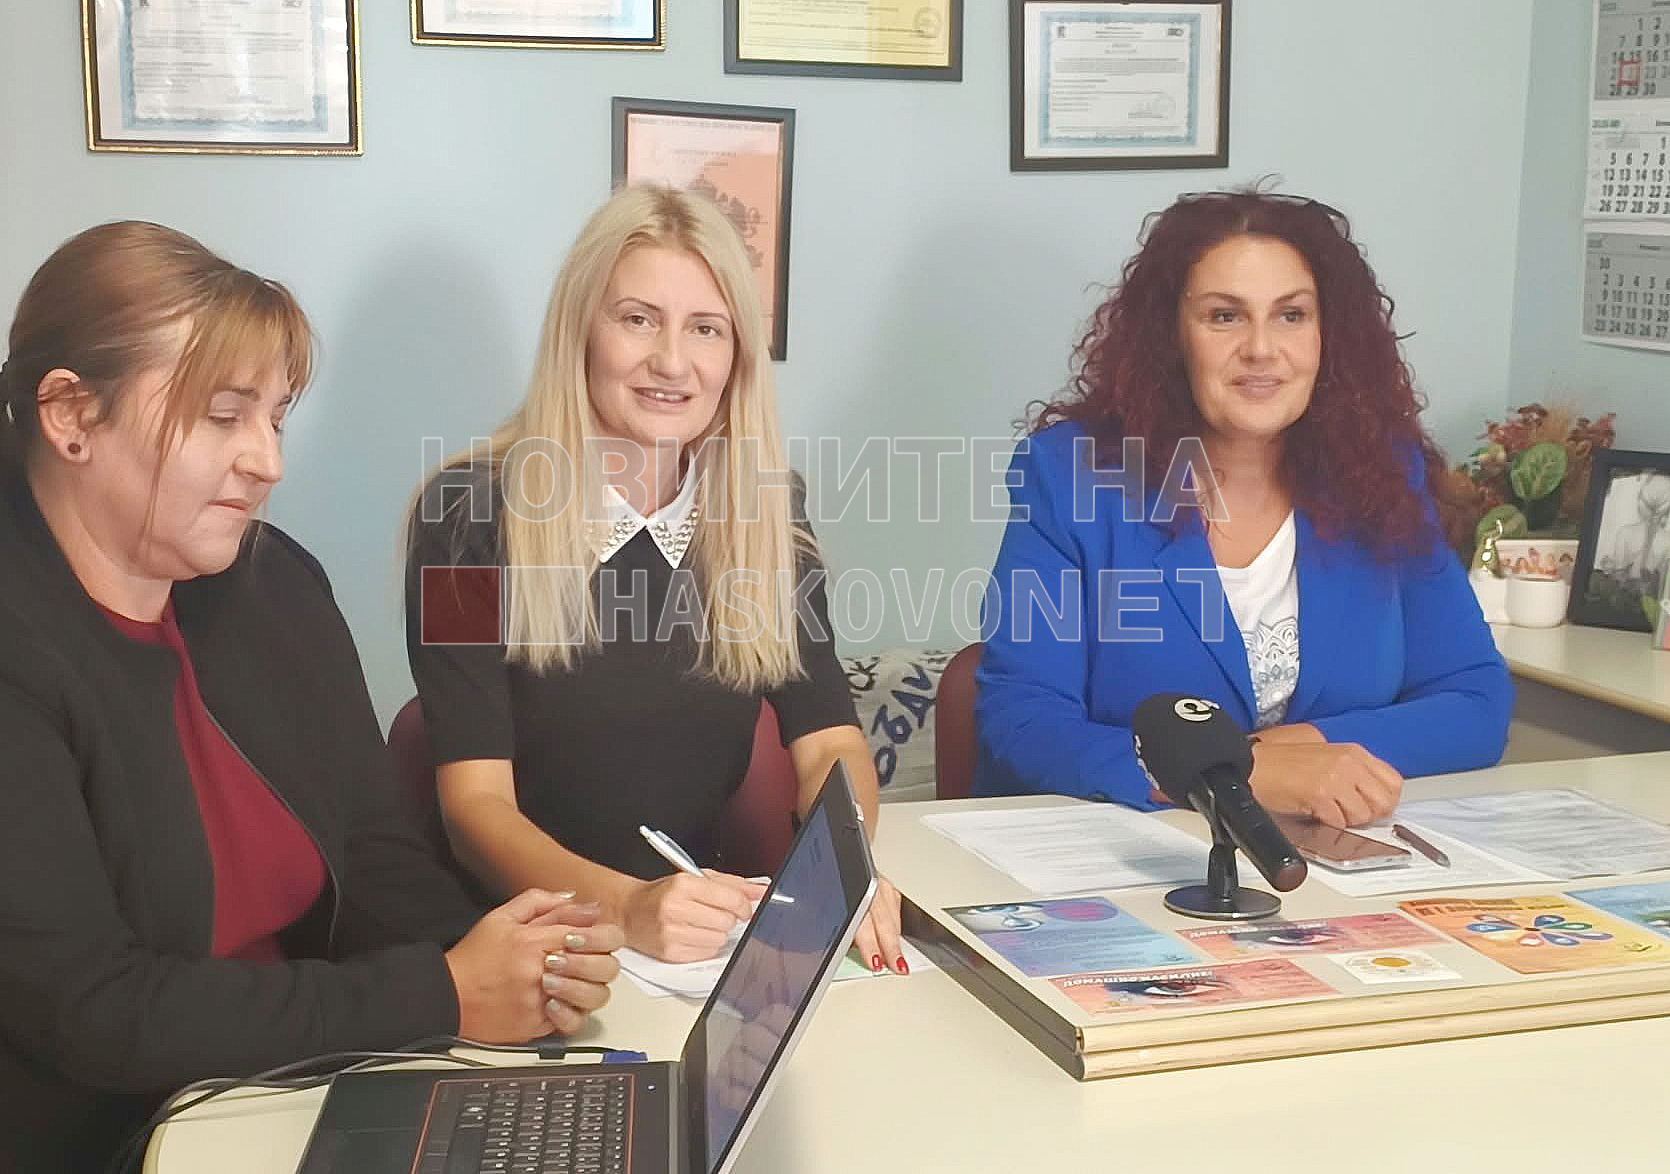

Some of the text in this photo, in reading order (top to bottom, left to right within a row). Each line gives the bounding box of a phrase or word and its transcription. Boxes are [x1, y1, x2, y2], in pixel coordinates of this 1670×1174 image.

[1638, 18, 1643, 30] 1
[1661, 136, 1666, 149] 1
[1610, 152, 1666, 166] 5 6 7 8
[1604, 168, 1664, 182] 12 13 14 15
[1603, 184, 1614, 197] 19
[1617, 184, 1630, 197] 20
[1633, 185, 1645, 197] 21
[1649, 185, 1661, 198] 22
[1600, 199, 1612, 212] 26
[1615, 200, 1628, 213] 27
